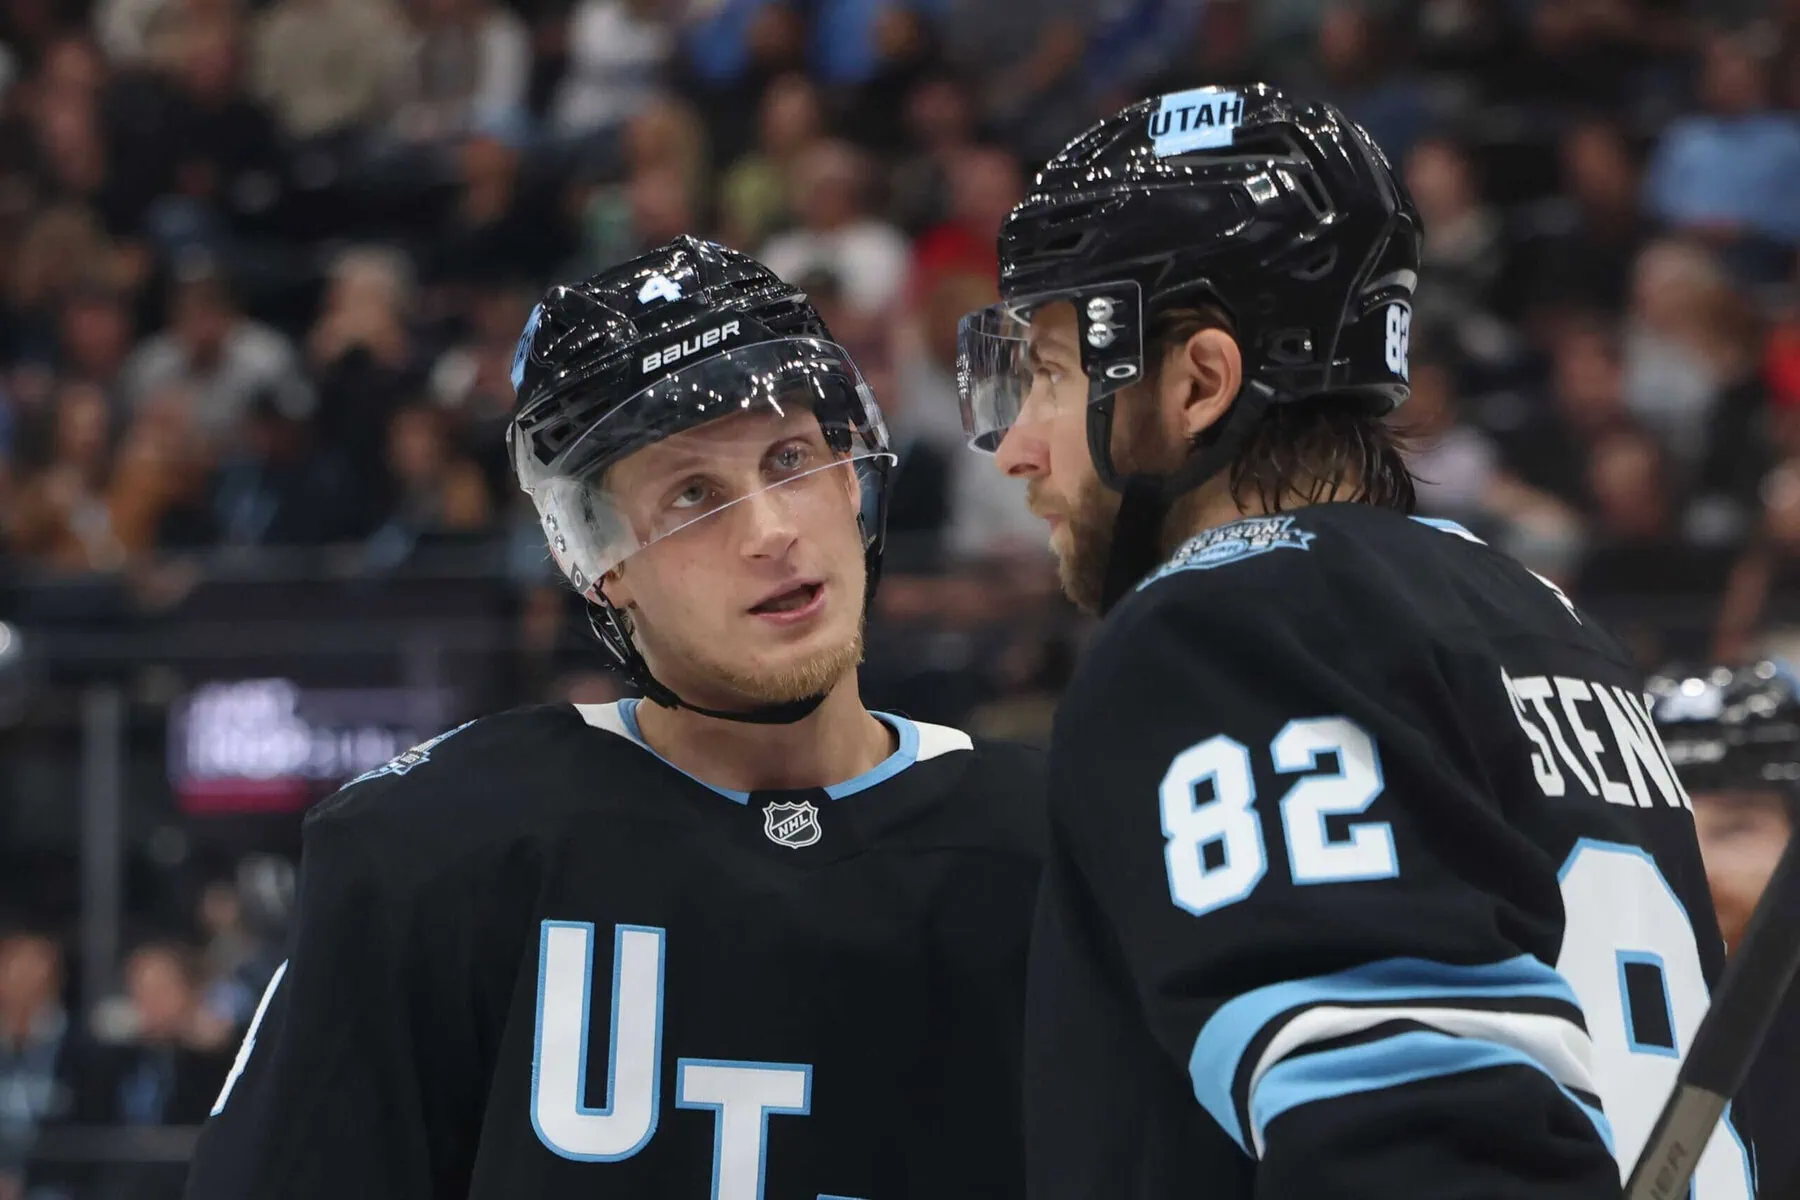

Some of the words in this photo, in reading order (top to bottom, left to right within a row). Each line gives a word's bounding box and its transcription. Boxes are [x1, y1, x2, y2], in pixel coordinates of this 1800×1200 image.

[1150, 100, 1241, 137] UTAH
[638, 275, 682, 304] 4
[777, 813, 809, 838] NHL
[1158, 715, 1400, 917] 82
[530, 919, 869, 1200] UT
